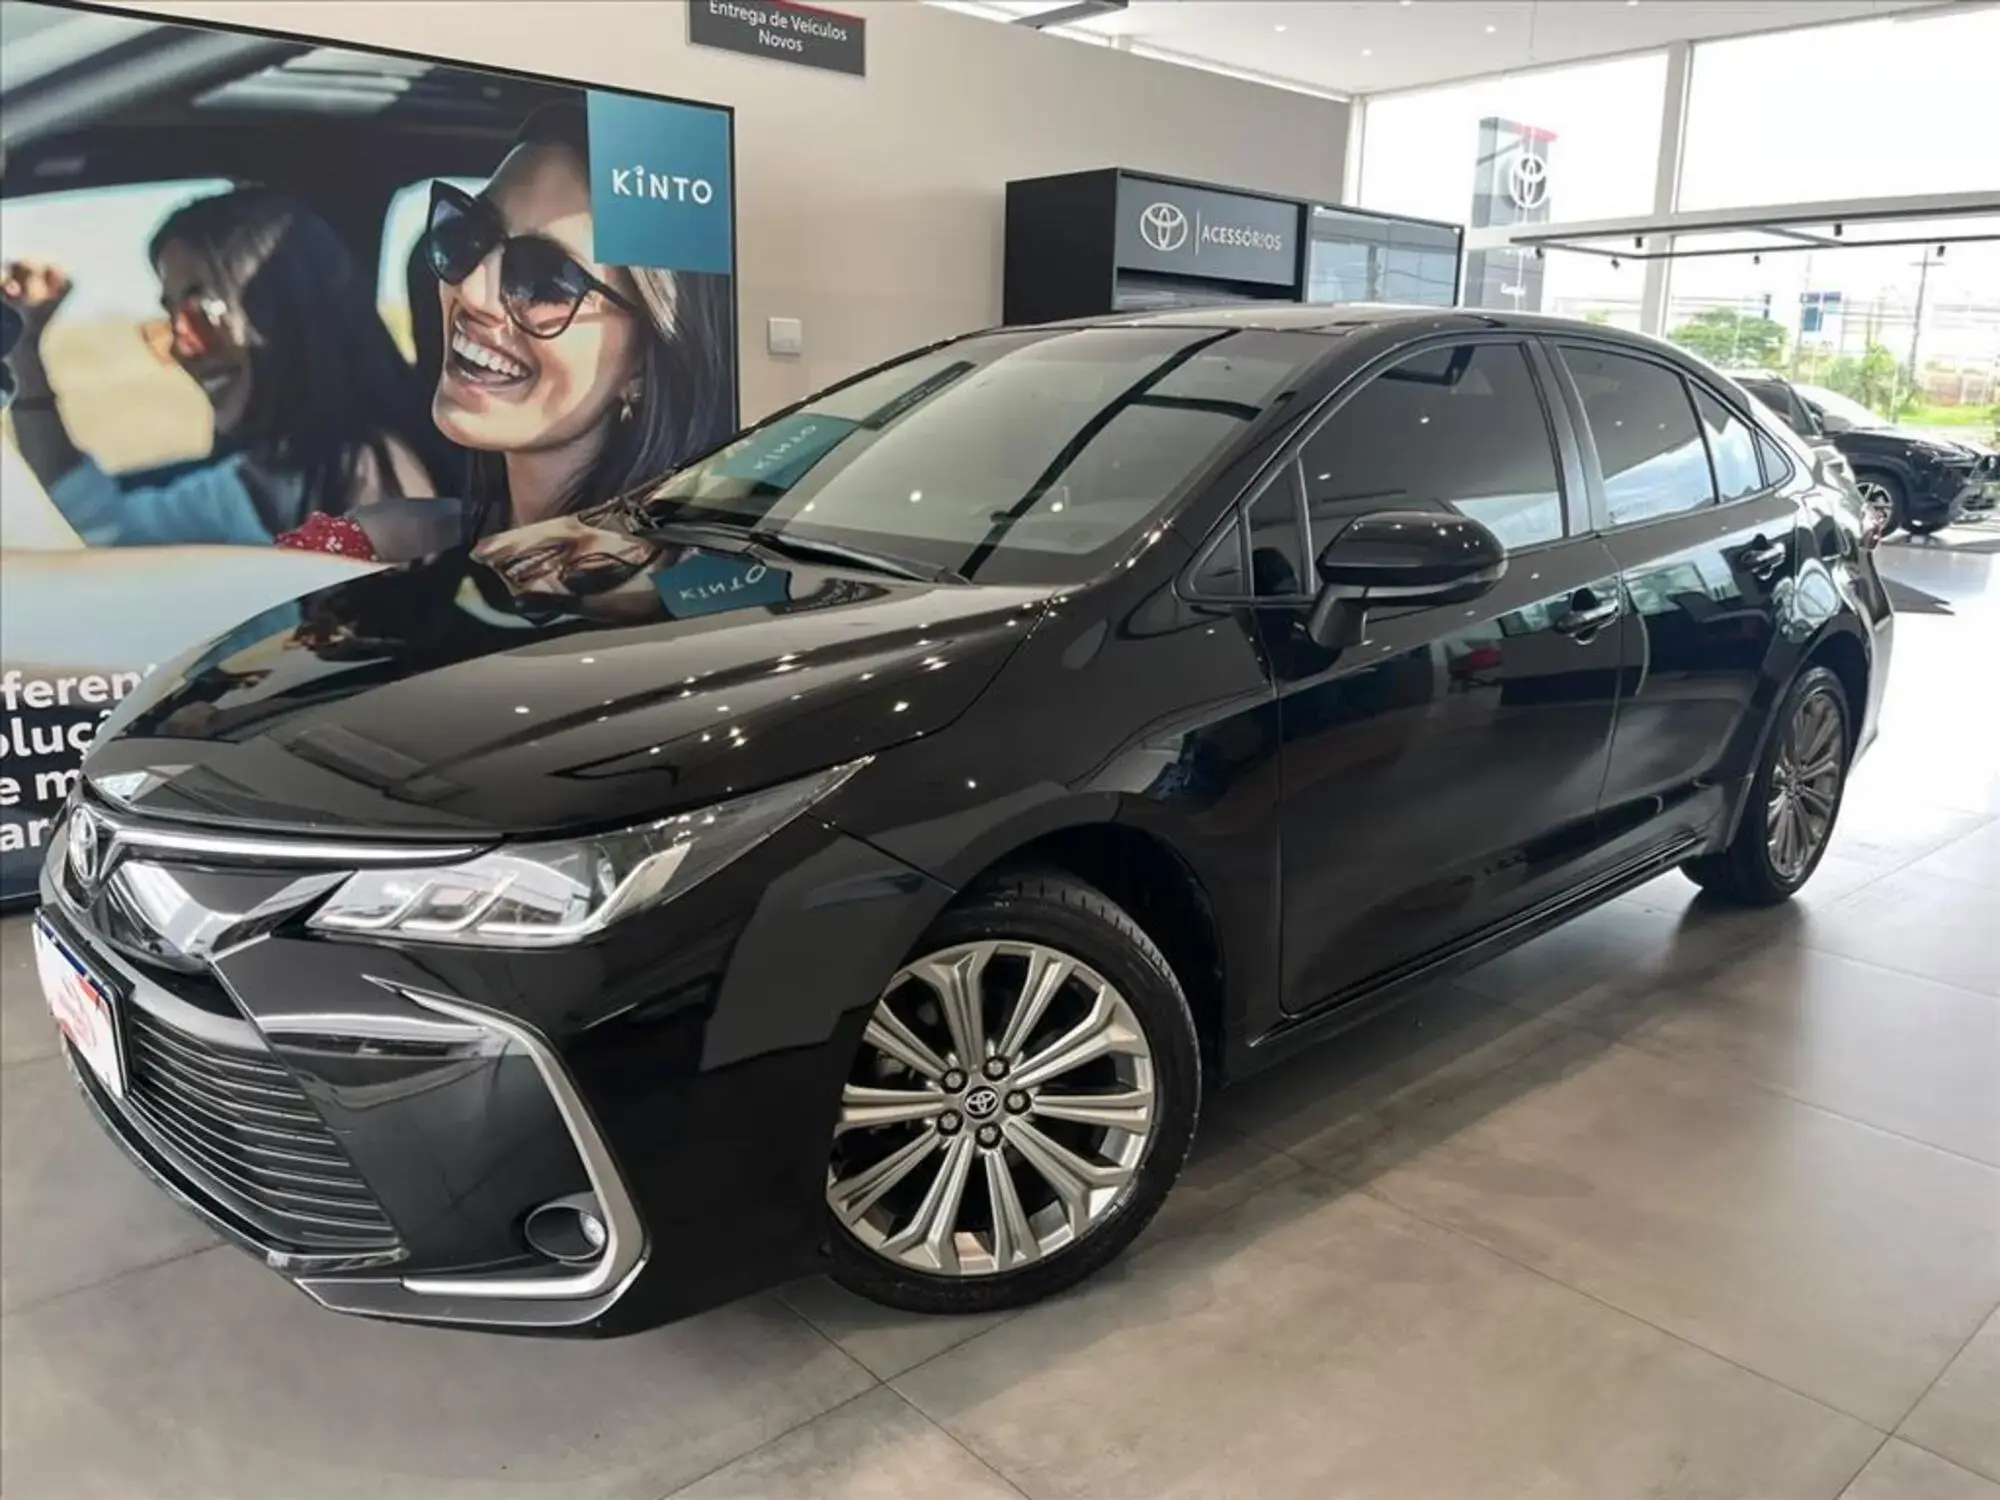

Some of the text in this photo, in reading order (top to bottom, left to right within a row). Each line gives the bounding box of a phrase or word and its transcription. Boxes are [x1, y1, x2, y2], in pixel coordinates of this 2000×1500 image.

[709, 1, 847, 41] Entrega de Veículos
[758, 29, 803, 51] Novos
